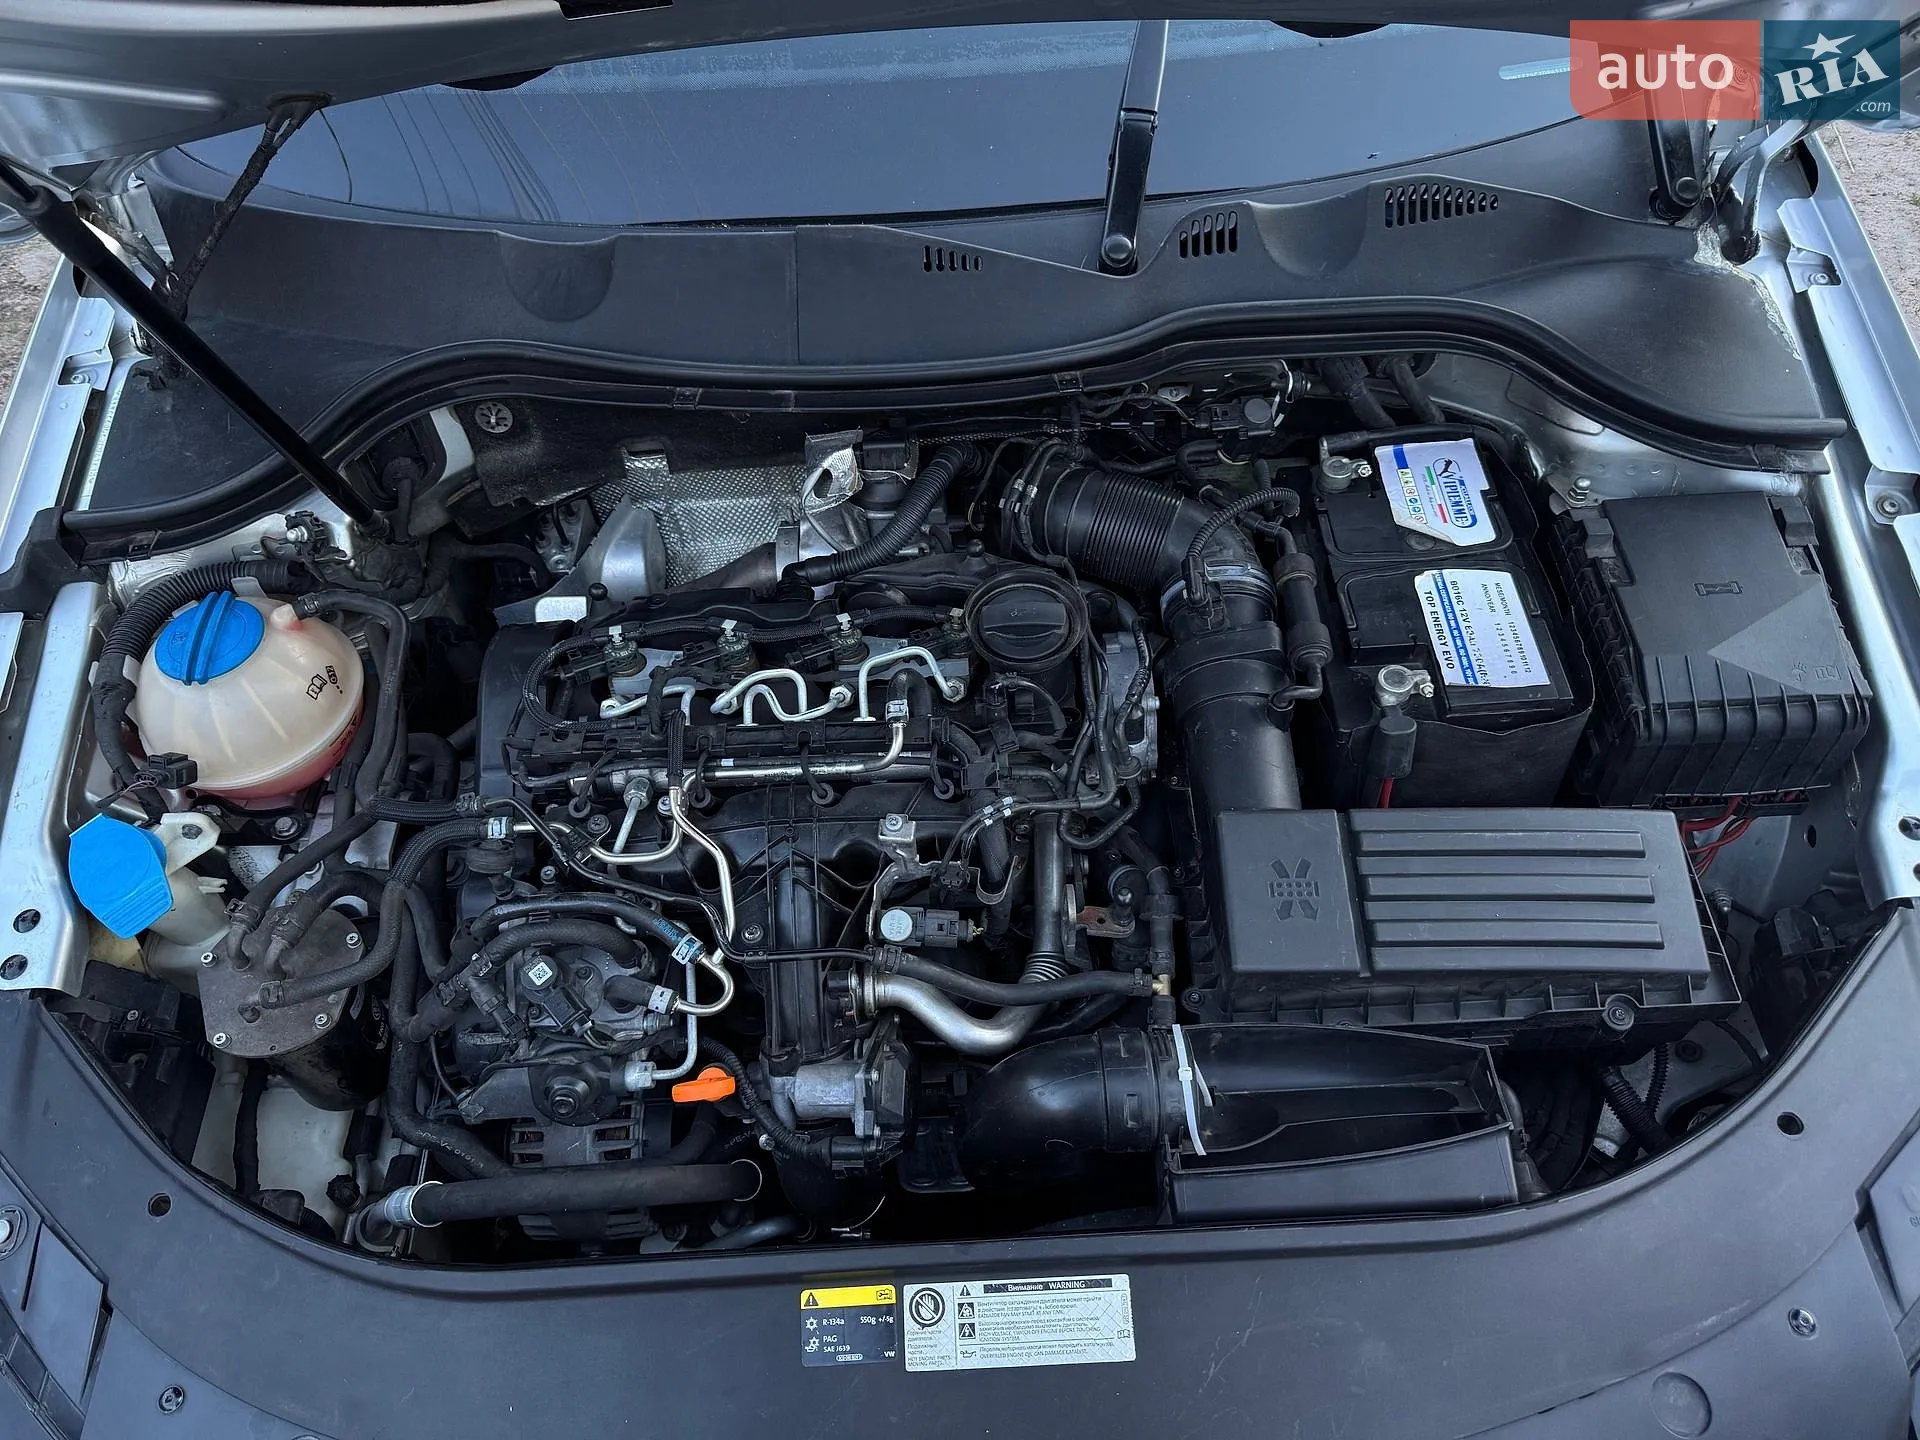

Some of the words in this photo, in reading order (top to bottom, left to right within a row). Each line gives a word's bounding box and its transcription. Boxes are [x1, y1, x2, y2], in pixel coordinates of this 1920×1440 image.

[1440, 474, 1469, 522] VIPIEMME
[1459, 607, 1471, 624] 12V
[1423, 590, 1436, 609] TOP
[1430, 610, 1449, 647] ENERGY
[1442, 650, 1455, 670] EVO
[1048, 1280, 1085, 1289] WARNING
[822, 1317, 845, 1326] R-134a
[860, 1315, 876, 1325] 550g
